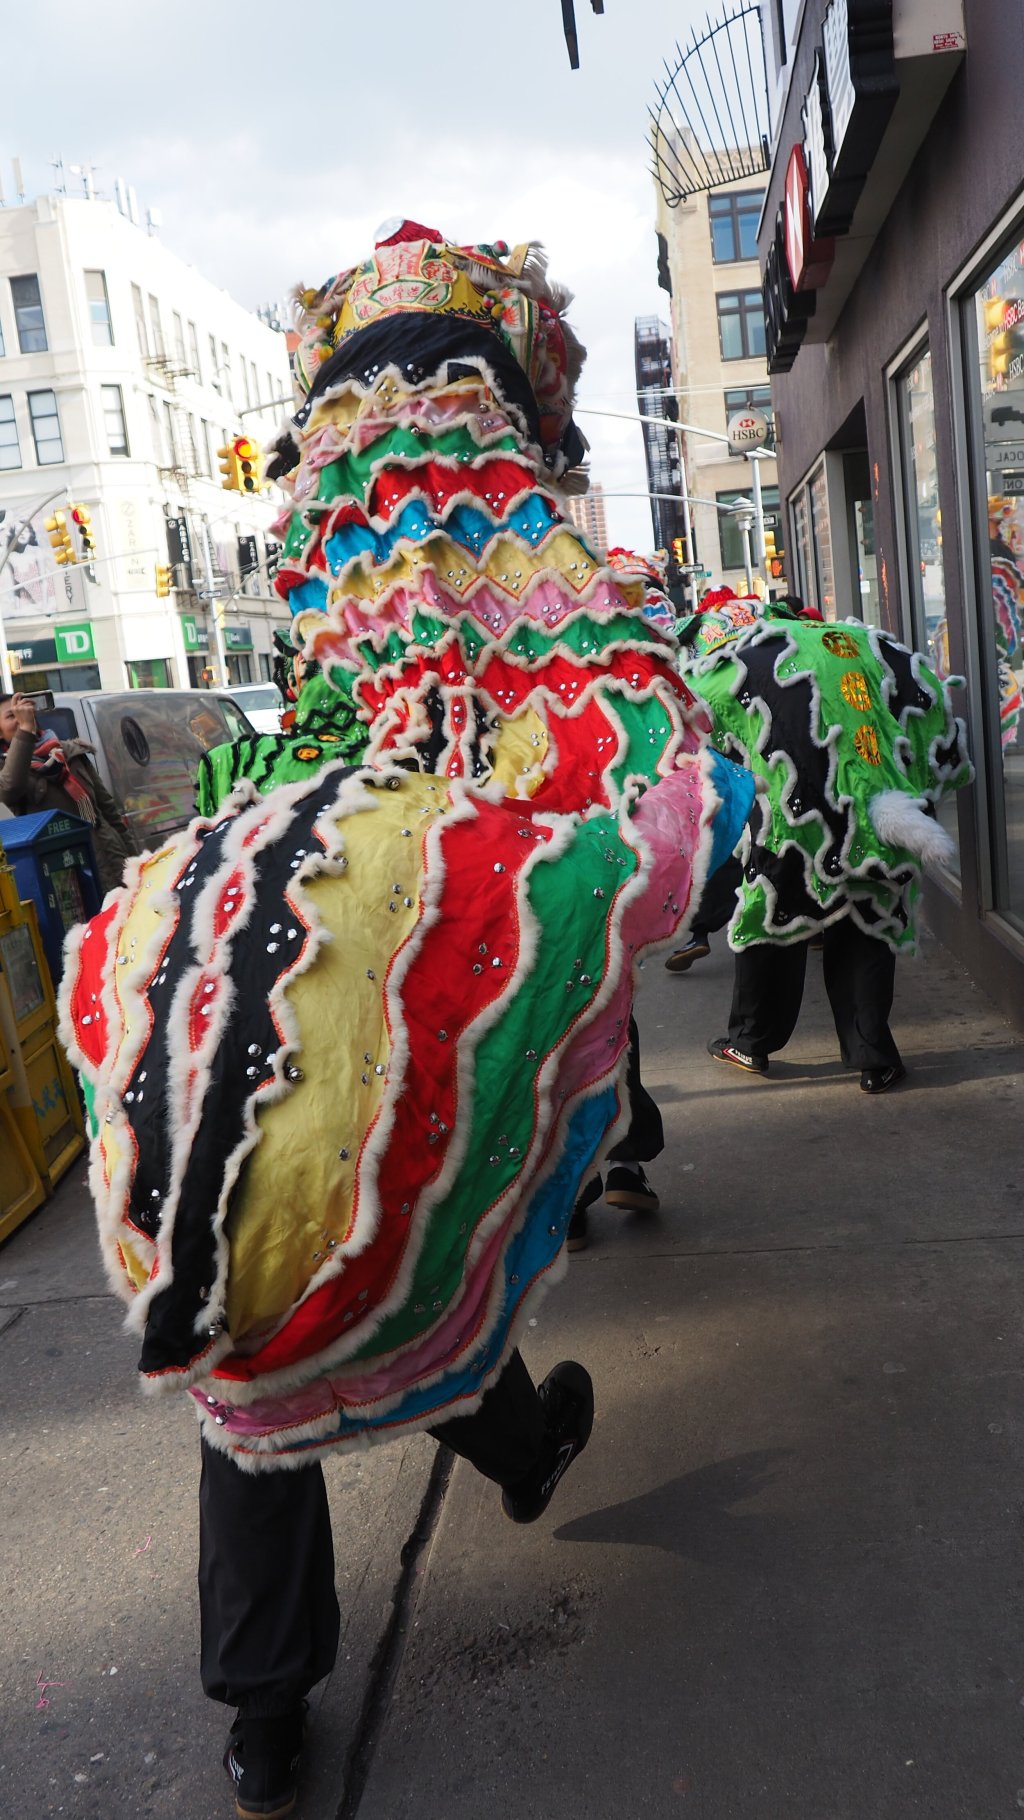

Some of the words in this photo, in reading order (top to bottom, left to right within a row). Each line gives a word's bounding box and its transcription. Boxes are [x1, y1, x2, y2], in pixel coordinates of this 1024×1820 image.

[732, 427, 765, 441] HSBC
[126, 519, 140, 566] ZARN
[59, 630, 91, 654] TD
[47, 819, 71, 835] FREE
